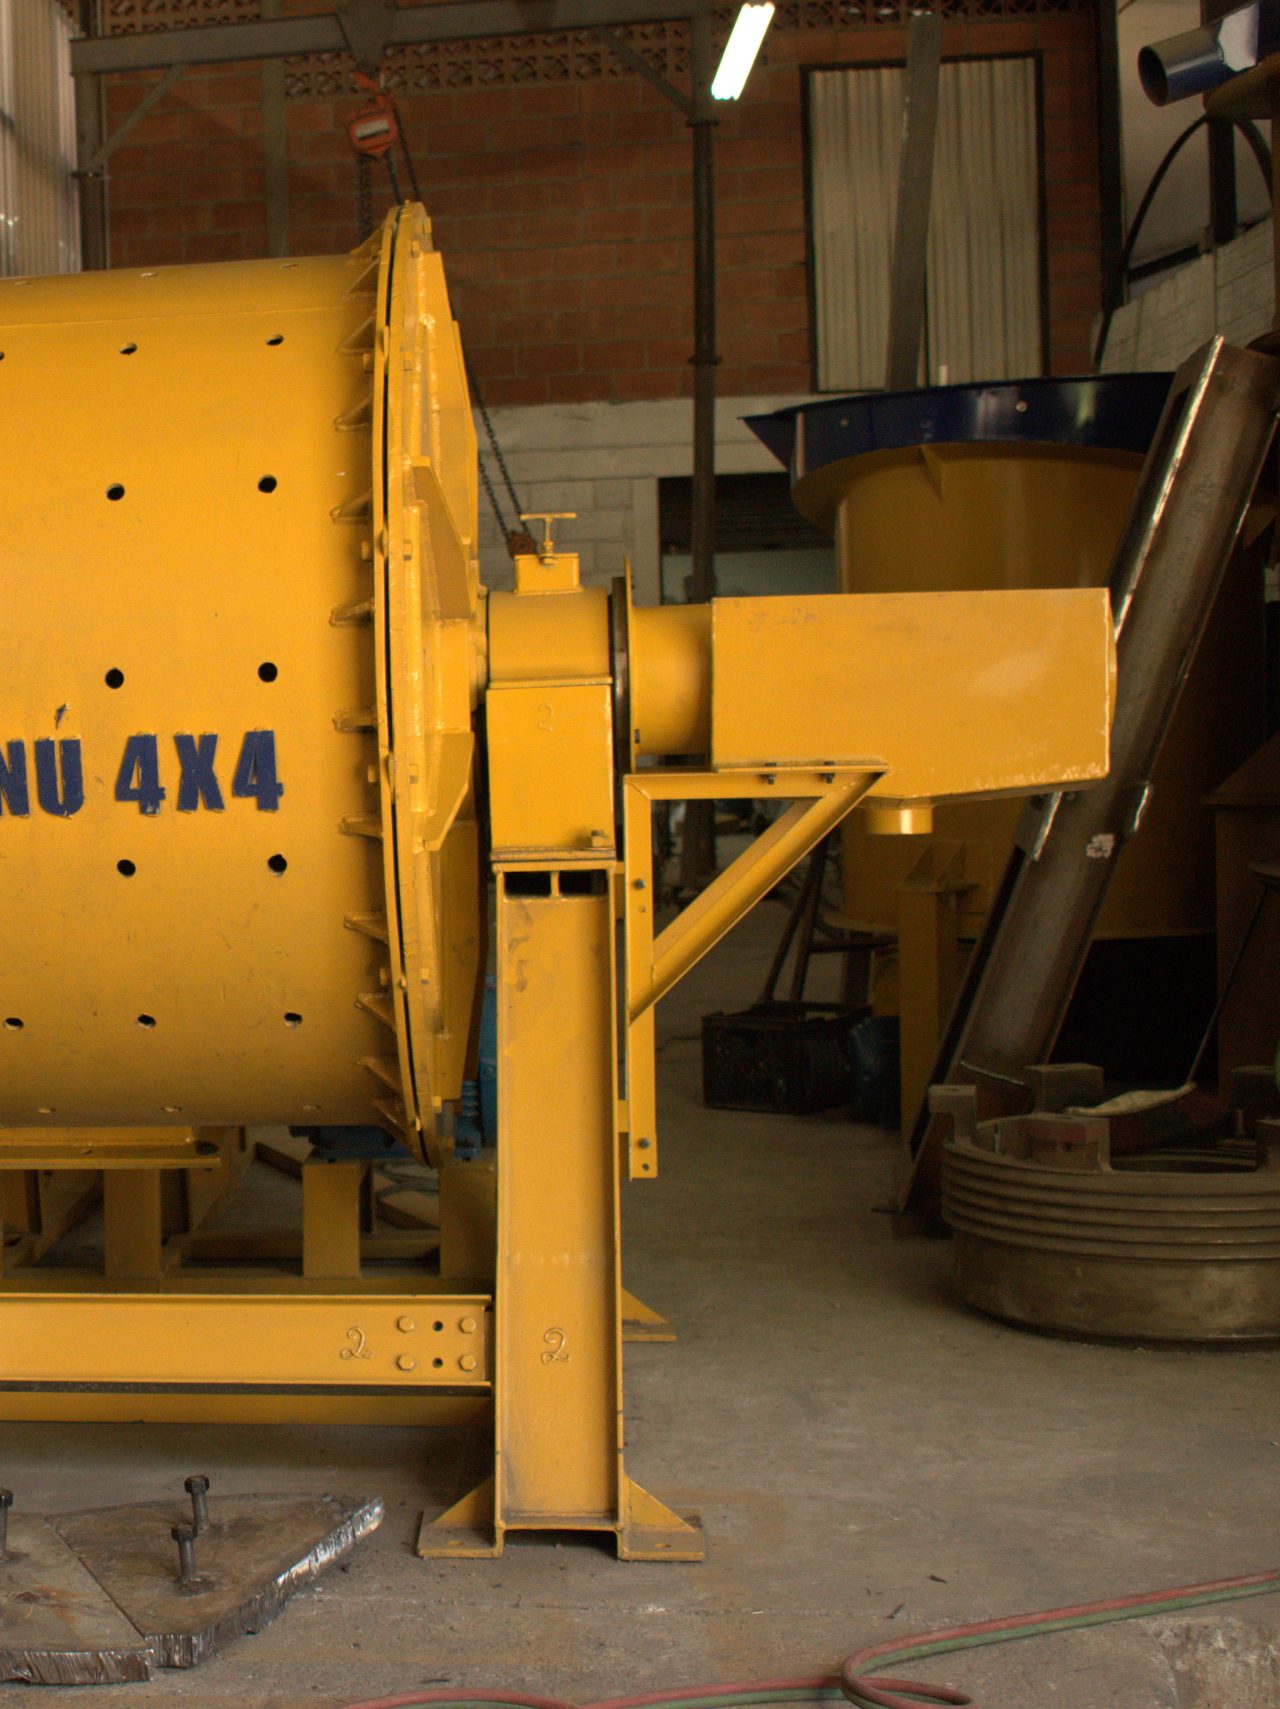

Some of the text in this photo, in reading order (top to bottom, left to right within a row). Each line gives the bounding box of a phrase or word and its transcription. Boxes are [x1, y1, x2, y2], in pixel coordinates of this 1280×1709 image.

[115, 728, 285, 816] 4X4
[339, 1326, 374, 1361] 2
[540, 1327, 570, 1366] 2
